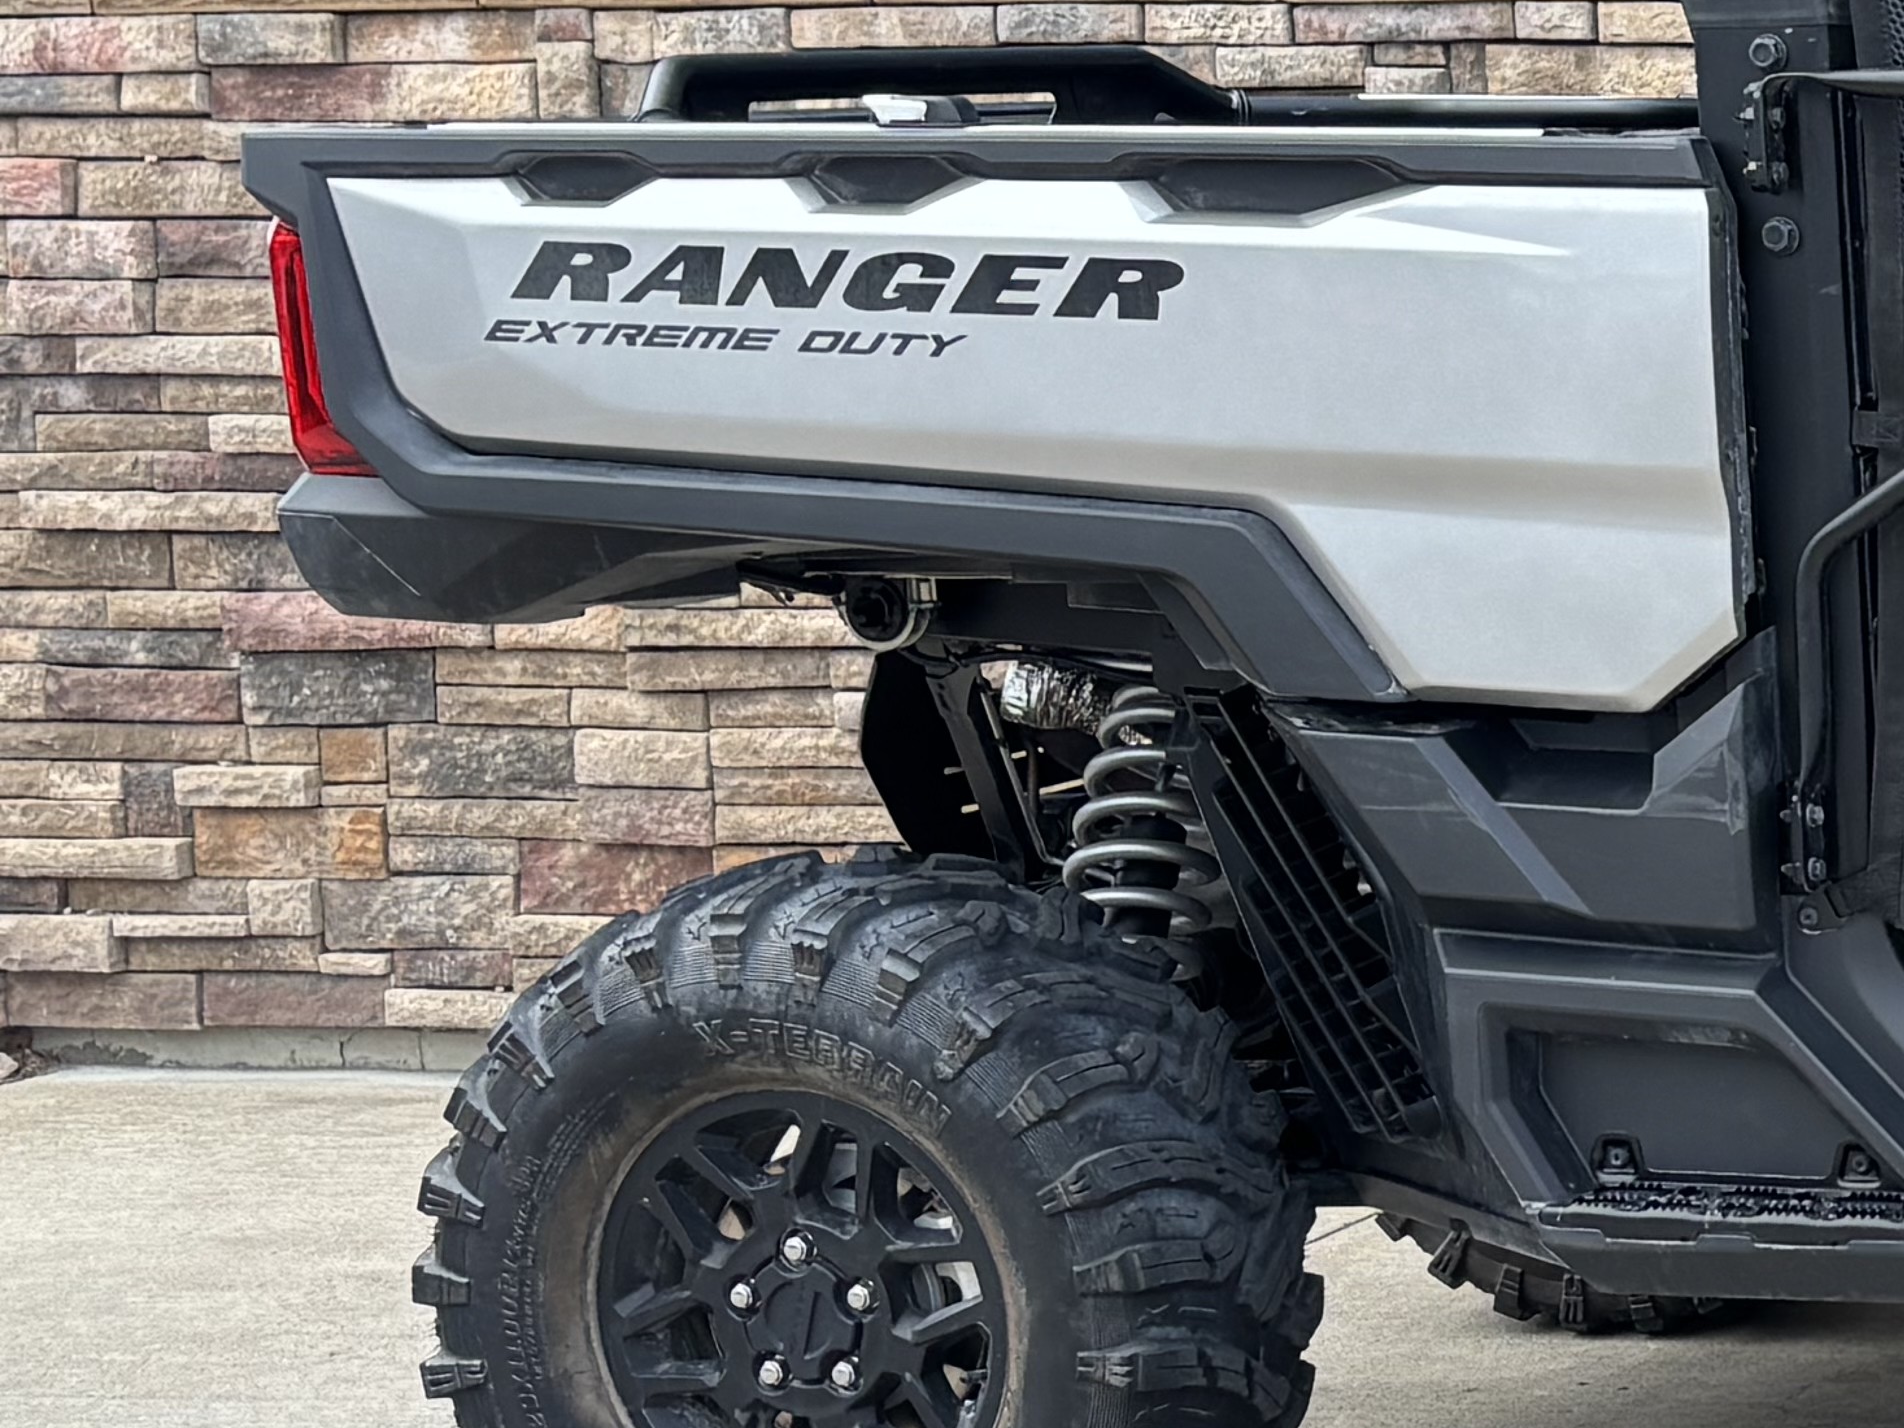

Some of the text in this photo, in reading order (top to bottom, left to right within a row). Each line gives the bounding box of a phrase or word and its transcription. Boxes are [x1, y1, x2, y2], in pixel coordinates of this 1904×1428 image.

[510, 240, 1185, 320] RANGER
[484, 319, 967, 358] EXTREME DUTY
